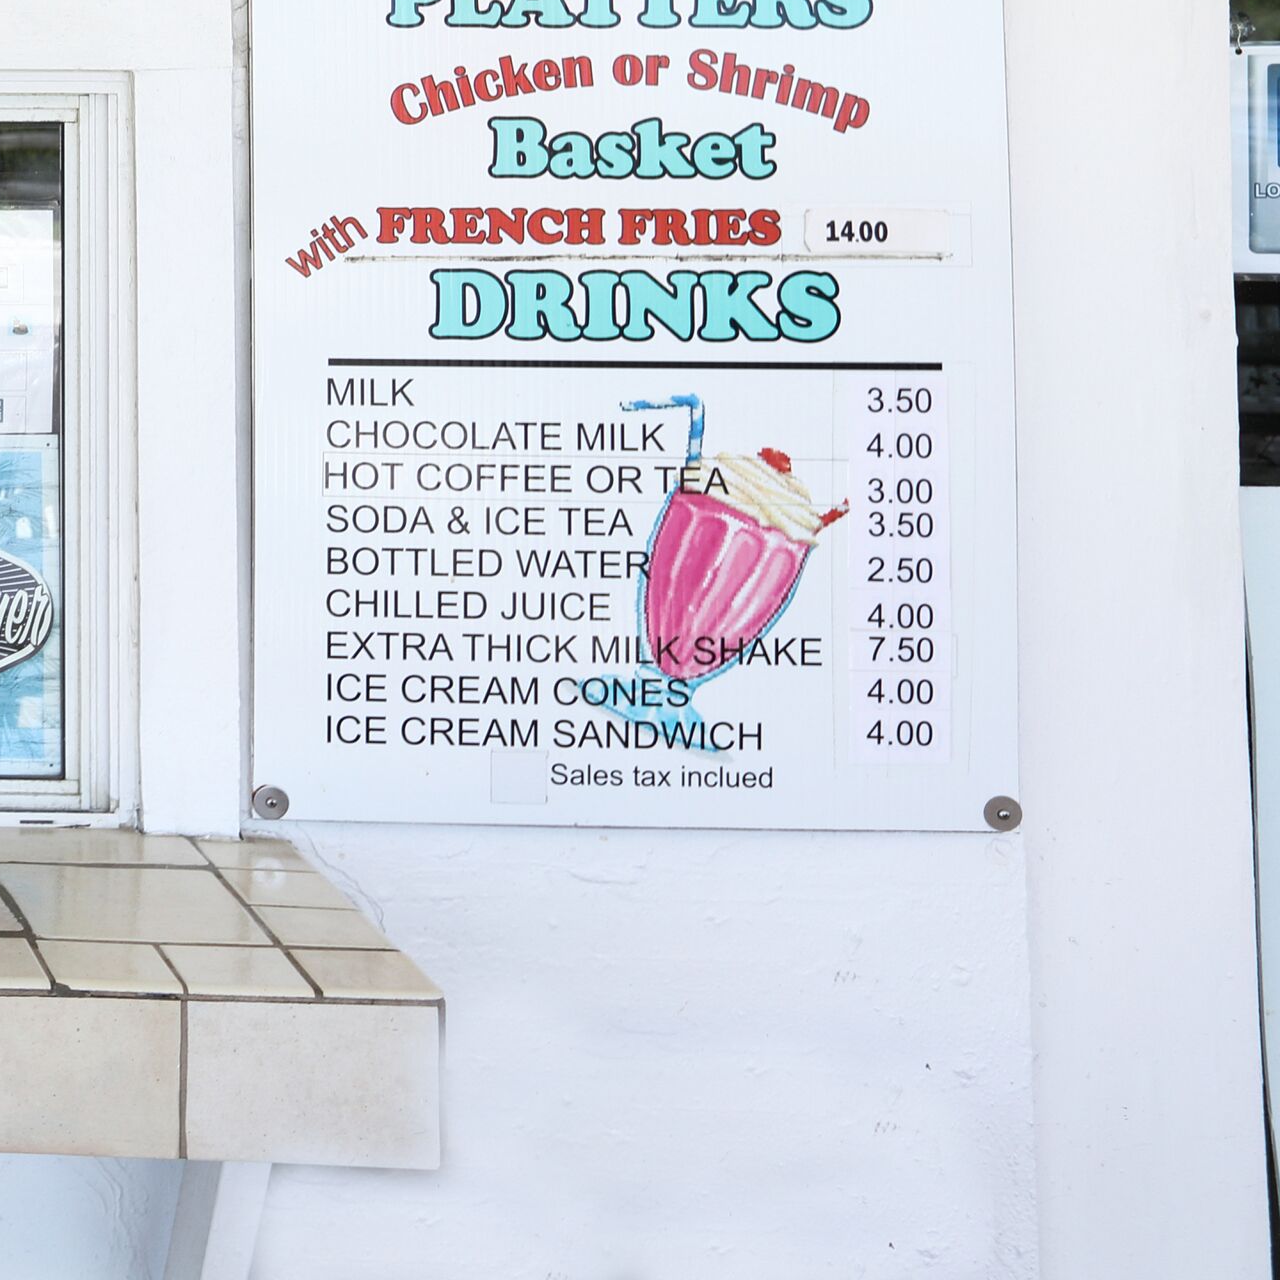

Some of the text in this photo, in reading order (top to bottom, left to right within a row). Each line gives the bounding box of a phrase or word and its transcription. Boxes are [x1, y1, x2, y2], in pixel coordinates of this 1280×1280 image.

[389, 48, 871, 134] Chicken or Shrimp
[486, 115, 778, 181] Basket
[284, 206, 889, 279] with FRENCH FRIES 14.00
[427, 267, 842, 344] DRINKS
[327, 377, 932, 414] MILK 3.50
[326, 504, 934, 538] SODA & ICE TEA 3.50
[326, 545, 933, 584] BOTTLED WATER 2.50
[326, 588, 934, 630] CHILLED JUICE 4.00
[550, 762, 773, 789] Sales tax inclued
